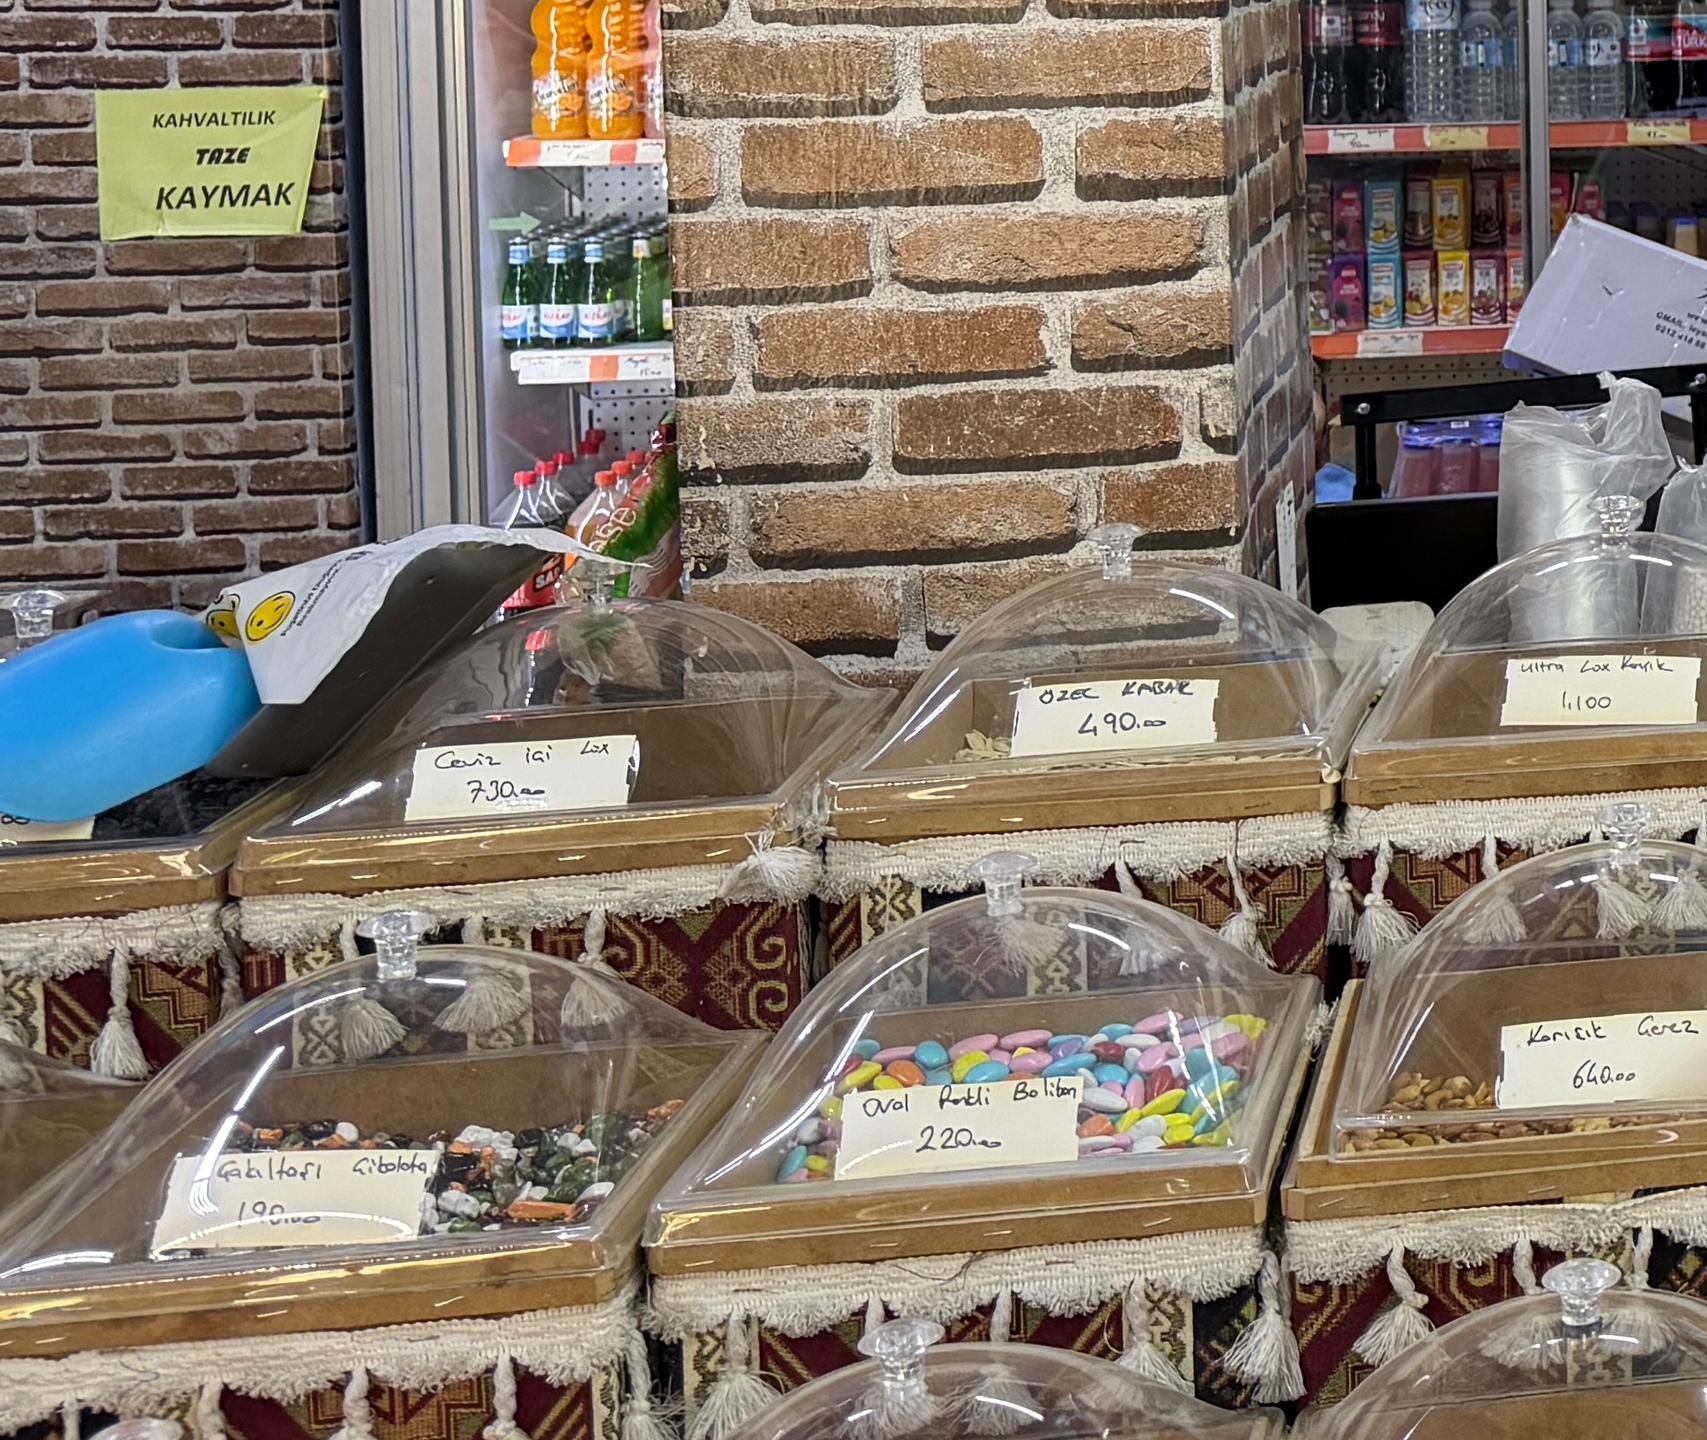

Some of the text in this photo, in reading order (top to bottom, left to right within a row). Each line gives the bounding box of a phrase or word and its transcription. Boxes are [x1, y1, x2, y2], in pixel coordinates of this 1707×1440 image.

[153, 111, 276, 128] KAHVALTILIK
[196, 147, 251, 165] TAZE
[156, 182, 295, 210] KAYMAK
